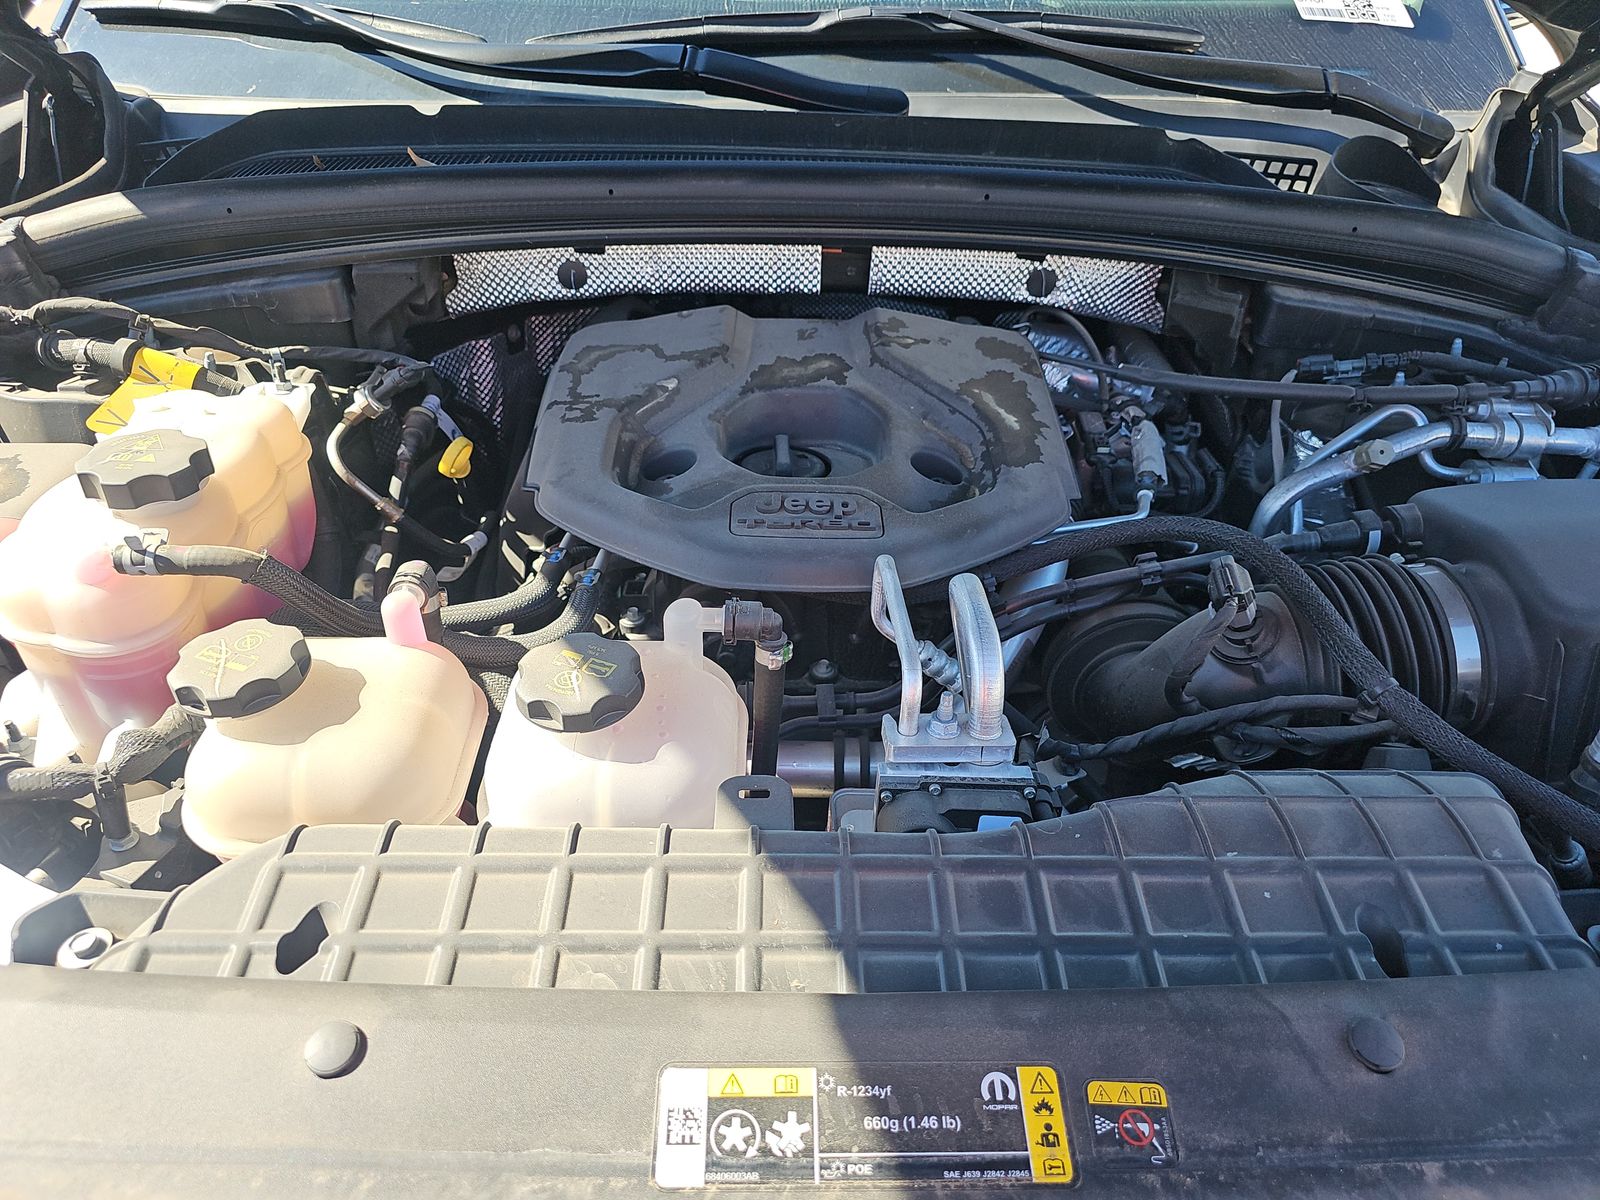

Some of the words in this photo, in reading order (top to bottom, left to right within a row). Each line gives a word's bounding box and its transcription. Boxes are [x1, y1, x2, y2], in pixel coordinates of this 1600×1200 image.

[755, 493, 858, 520] Jeep
[836, 1085, 892, 1099] R-1234yf
[863, 1116, 899, 1132] 660g
[903, 1115, 939, 1132] (1.46
[942, 1115, 961, 1132] lb)
[847, 1163, 874, 1176] POE
[943, 1170, 961, 1178] SAE
[962, 1170, 981, 1178] J639
[983, 1170, 1005, 1178] J2842
[1007, 1169, 1030, 1177] J2845
